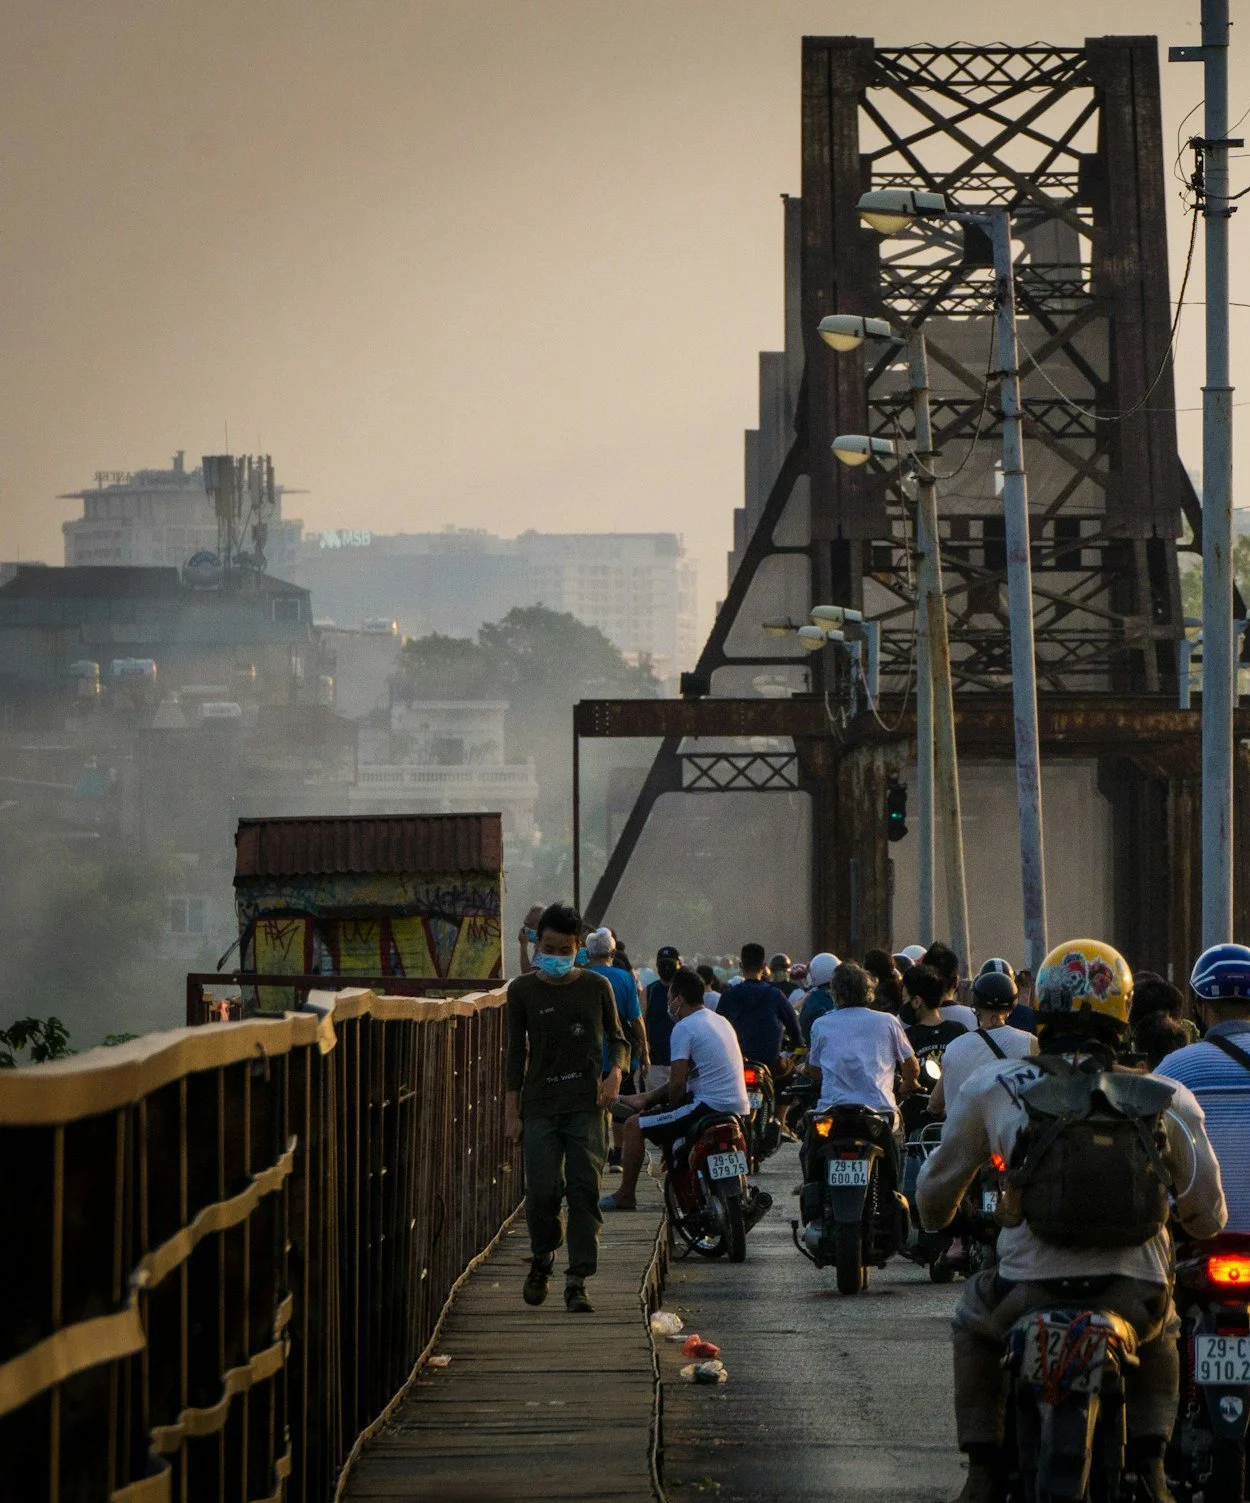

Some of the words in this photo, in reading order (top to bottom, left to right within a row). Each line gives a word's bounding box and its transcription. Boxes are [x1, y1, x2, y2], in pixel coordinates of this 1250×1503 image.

[342, 530, 371, 546] MSB
[712, 1153, 739, 1167] 29-G1
[831, 1173, 866, 1184] 600.04
